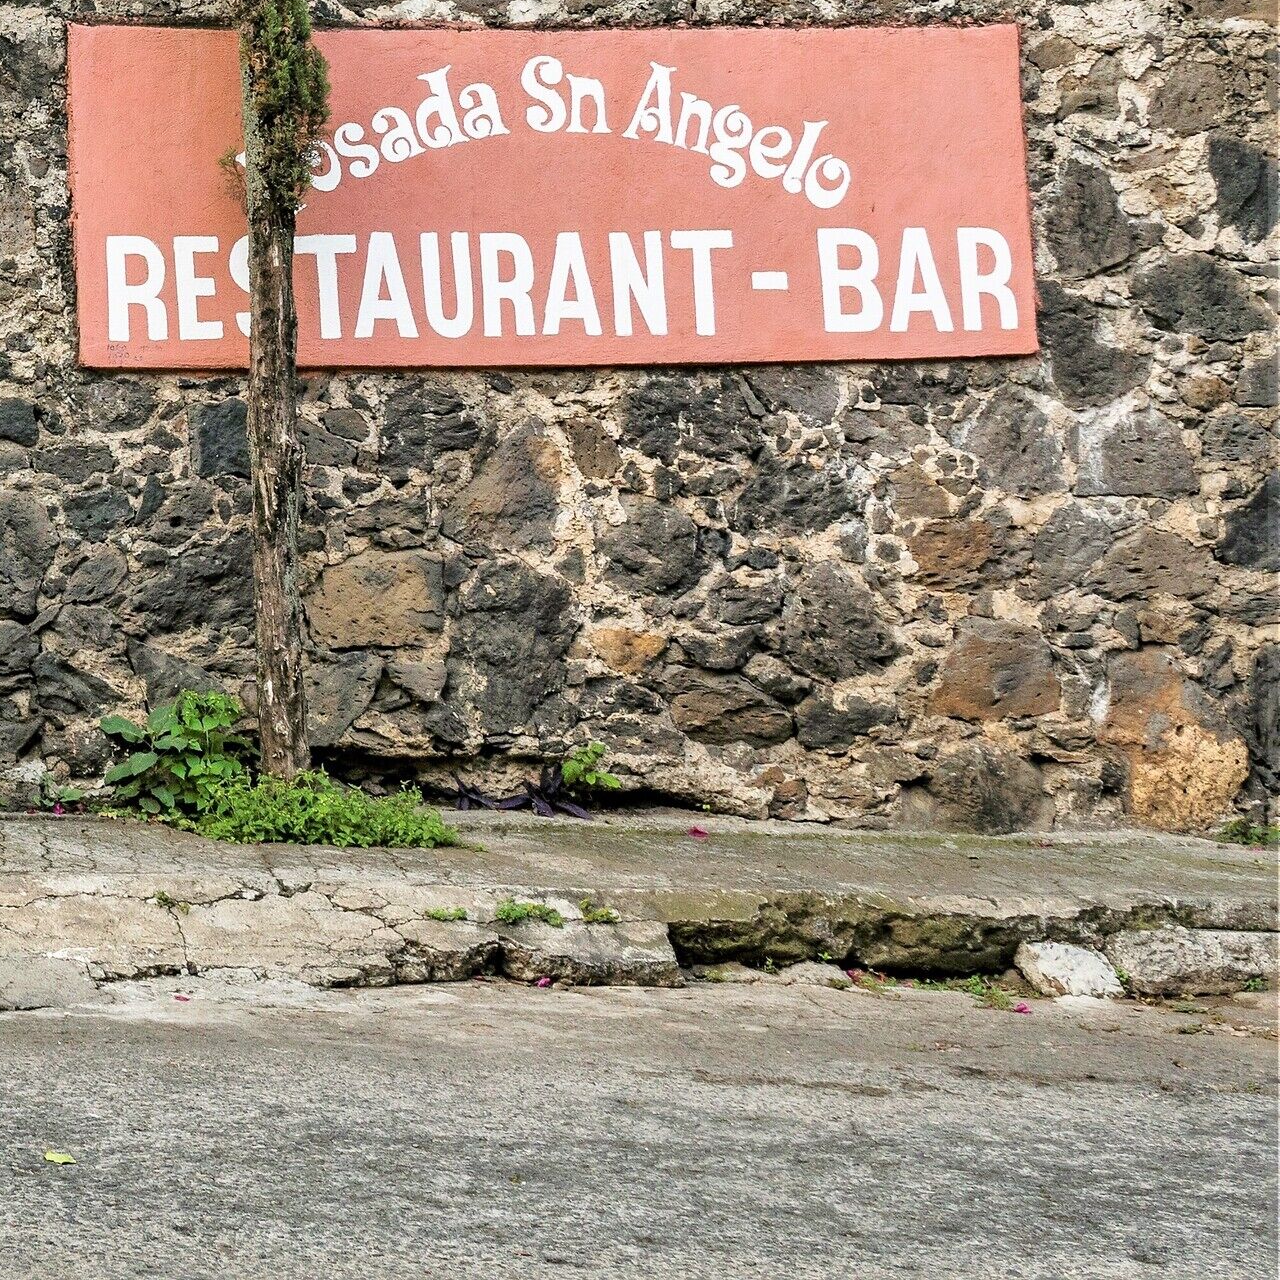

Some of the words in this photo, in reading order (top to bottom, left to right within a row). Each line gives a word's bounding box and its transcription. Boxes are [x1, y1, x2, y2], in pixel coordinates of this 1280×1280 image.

[235, 65, 509, 214] osada
[521, 54, 613, 135] Sn
[626, 61, 852, 210] Angelo
[817, 226, 1020, 335] BAR
